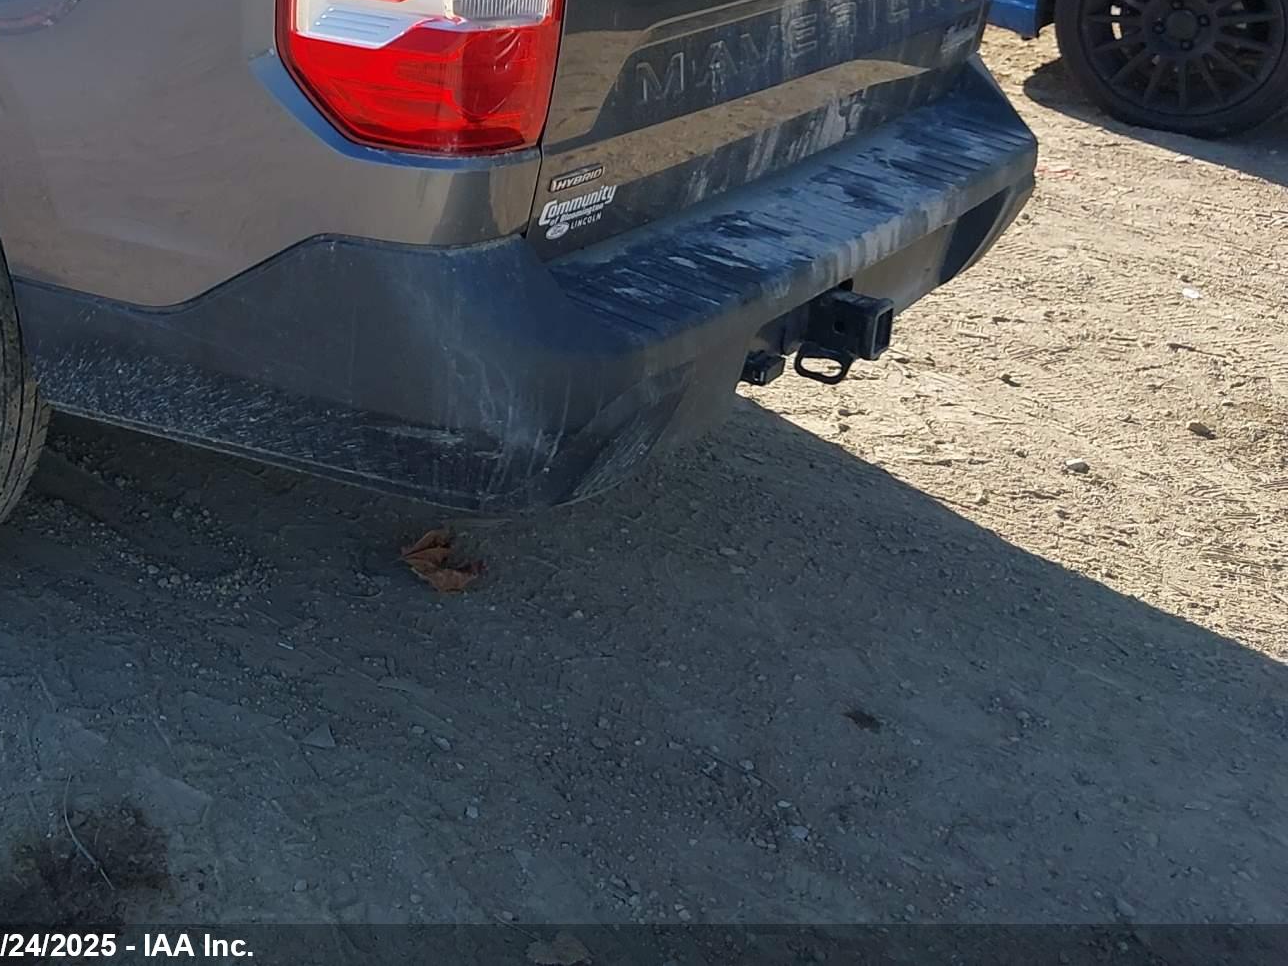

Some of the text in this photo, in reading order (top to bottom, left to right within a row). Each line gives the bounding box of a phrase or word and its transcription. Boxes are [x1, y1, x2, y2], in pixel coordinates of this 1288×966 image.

[556, 166, 603, 190] HYBRID
[538, 184, 617, 227] Community
[570, 212, 603, 230] LINCOLN
